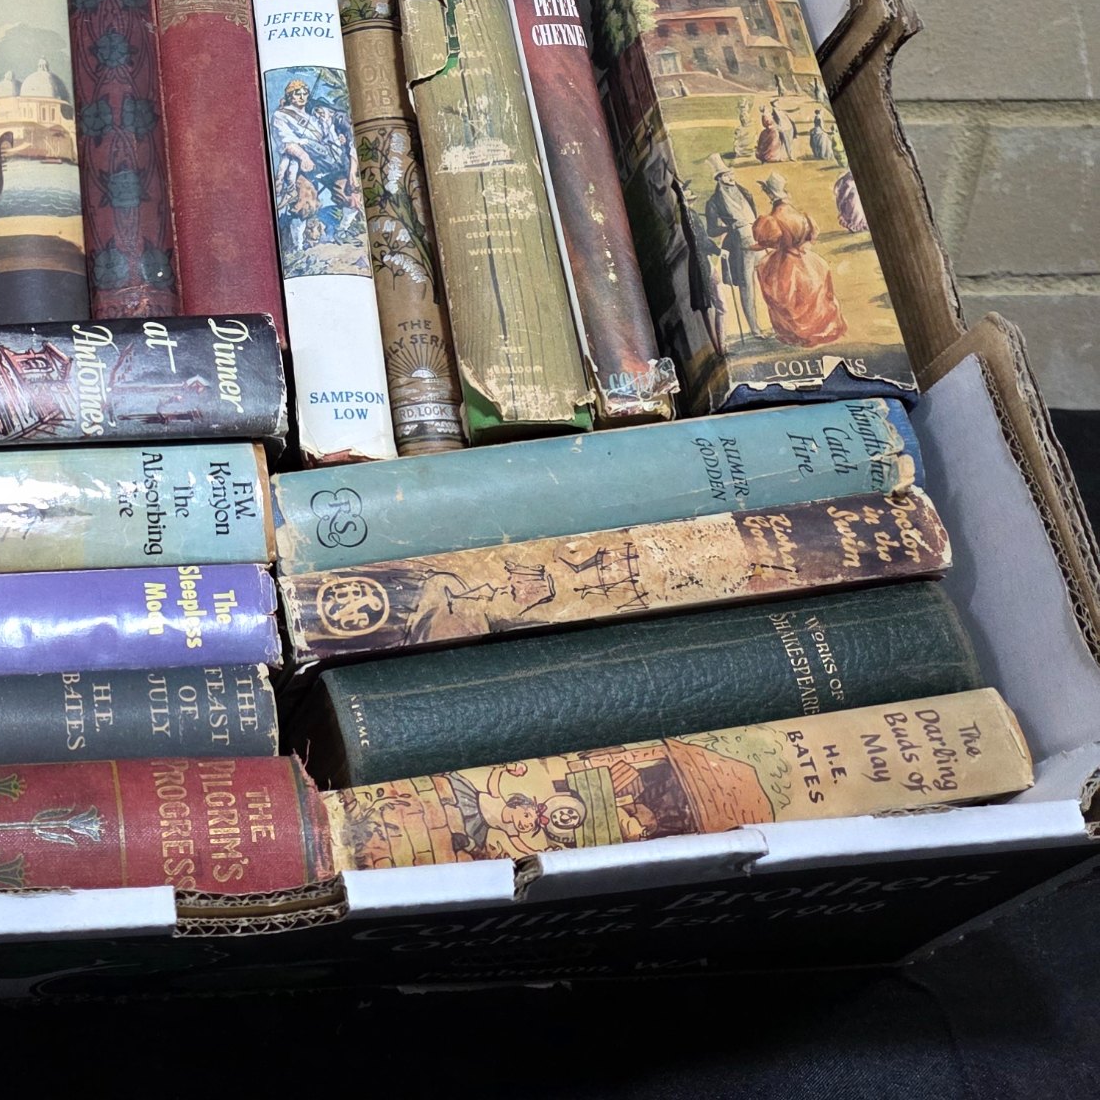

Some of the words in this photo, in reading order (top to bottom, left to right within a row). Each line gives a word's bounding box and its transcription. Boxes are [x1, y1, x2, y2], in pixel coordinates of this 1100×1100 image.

[263, 11, 335, 27] JEFFERY
[267, 26, 335, 41] FARNOL
[142, 321, 178, 374] at
[398, 320, 432, 331] THE
[207, 317, 253, 414] Dinner
[309, 391, 385, 405] SAMPSON
[334, 408, 369, 420] LOW
[418, 405, 448, 417] LOCK
[691, 437, 727, 502] GODDEN
[717, 435, 750, 498] RUMER
[786, 431, 820, 478] Fire
[822, 426, 858, 477] Catch
[141, 451, 167, 556] Absorbing
[209, 460, 232, 536] Kenyon
[862, 505, 885, 526] in
[884, 497, 922, 565] Doctor
[143, 582, 168, 636] Moon
[177, 566, 203, 649] Sleepless
[212, 589, 238, 625] The
[768, 612, 821, 716] SHAKESPEARE
[804, 615, 838, 675] WORKS
[829, 678, 845, 701] OF
[61, 672, 86, 751] BATES
[146, 673, 172, 737] JULY
[178, 685, 200, 721] OF
[203, 667, 230, 745] FEAST
[235, 676, 259, 732] THE
[787, 731, 825, 804] BATES
[860, 734, 892, 784] May
[883, 712, 921, 764] Buds
[908, 770, 931, 795] of
[915, 709, 958, 791] Darling
[959, 721, 983, 759] The
[151, 760, 197, 891] PROGRESS
[245, 787, 276, 843] THE
[350, 903, 639, 941] Collins
[660, 869, 1002, 911] Brothers
